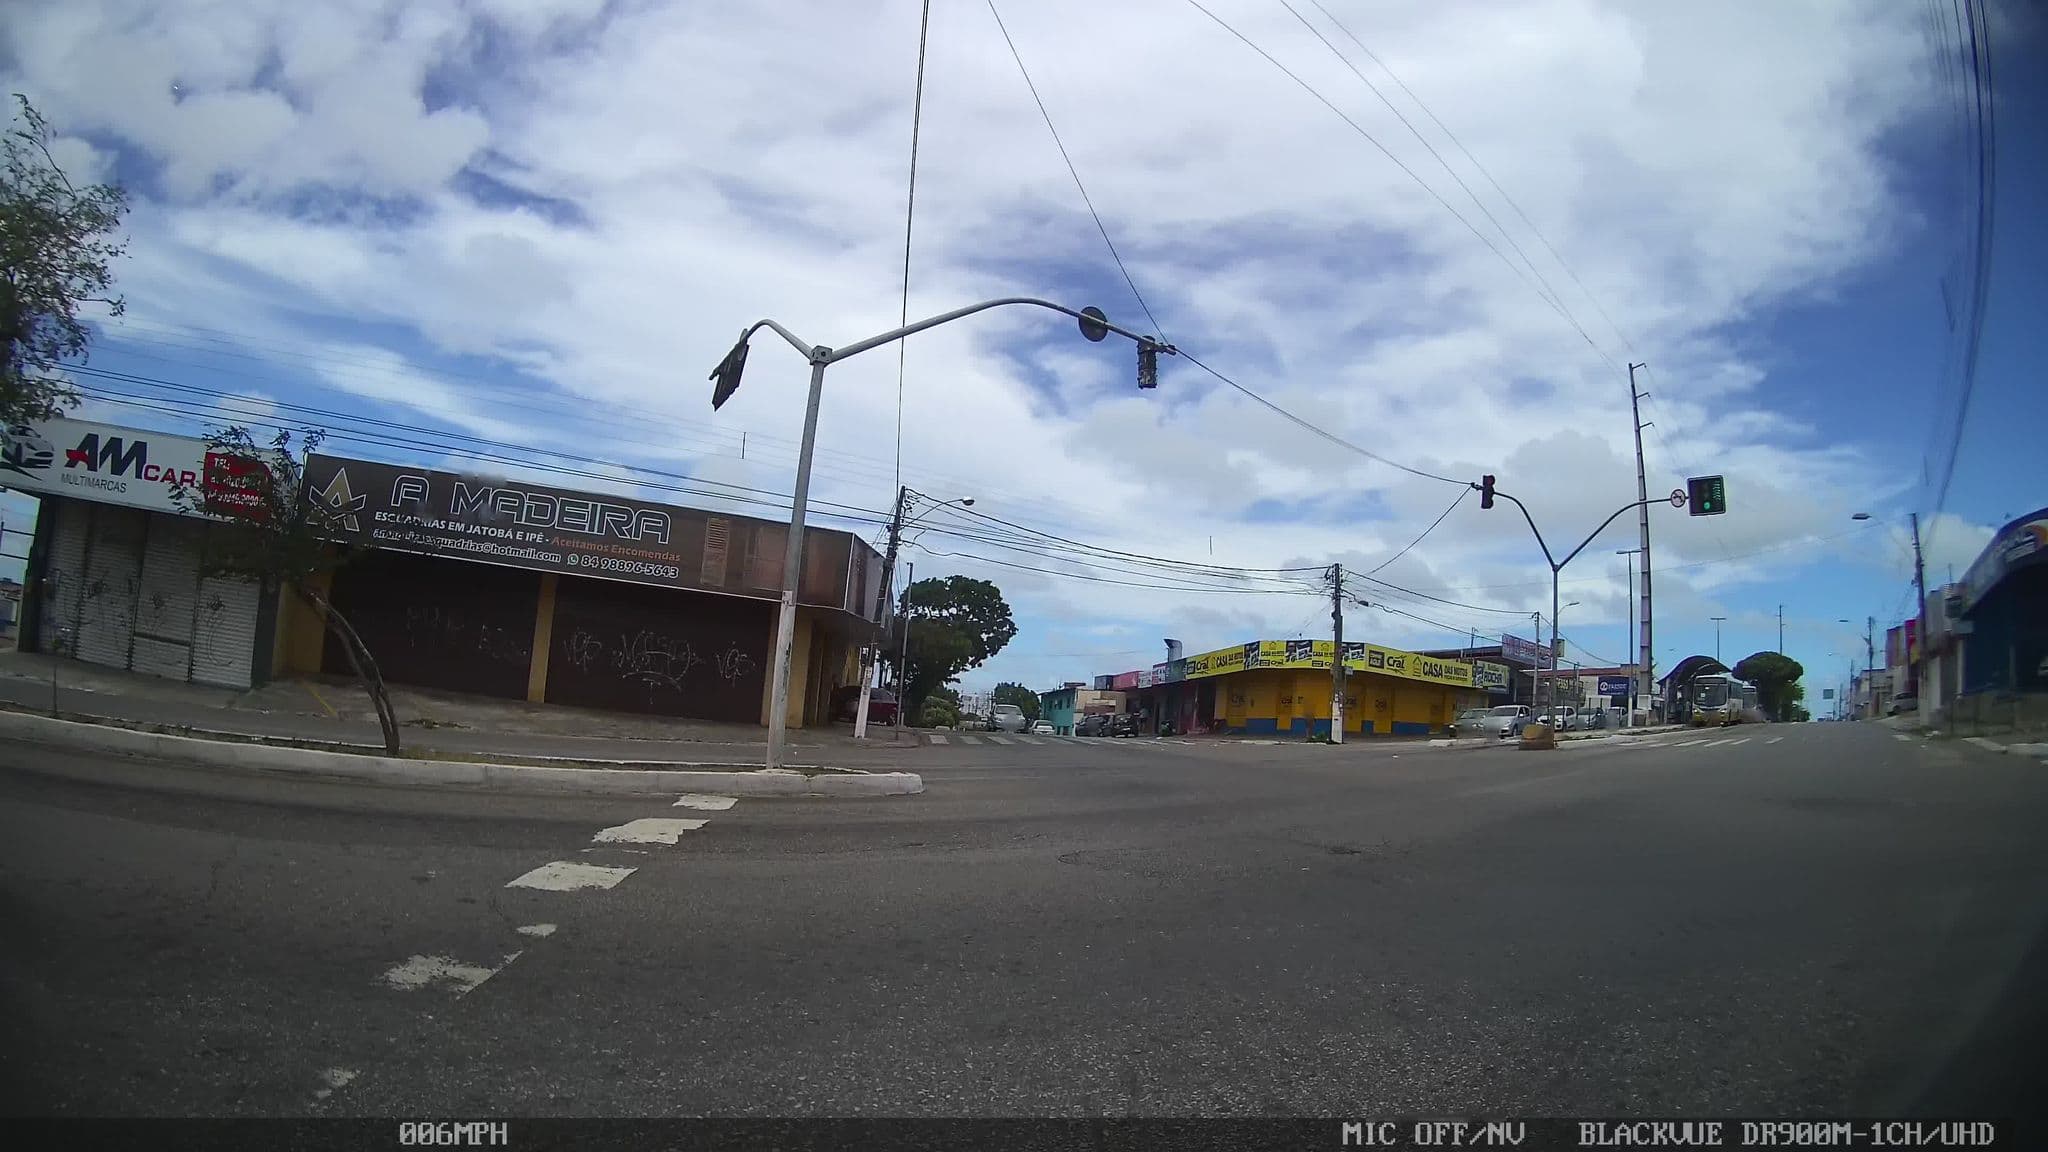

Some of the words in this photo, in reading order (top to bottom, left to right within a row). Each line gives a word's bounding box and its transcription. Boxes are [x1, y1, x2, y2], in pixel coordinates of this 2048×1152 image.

[60, 472, 127, 494] MULTIMARCAS
[391, 475, 430, 507] A
[451, 482, 672, 545] MADEIRA
[448, 521, 465, 533] EM
[467, 524, 513, 540] JATOBÁ
[516, 531, 523, 540] E
[526, 531, 543, 543] IPÊ
[551, 536, 610, 553] Aceitamos
[611, 544, 681, 562] Encomendas
[581, 555, 600, 568] 84
[602, 557, 680, 579] 98896-5643
[1386, 656, 1406, 669] Cral
[1423, 661, 1443, 679] CASA
